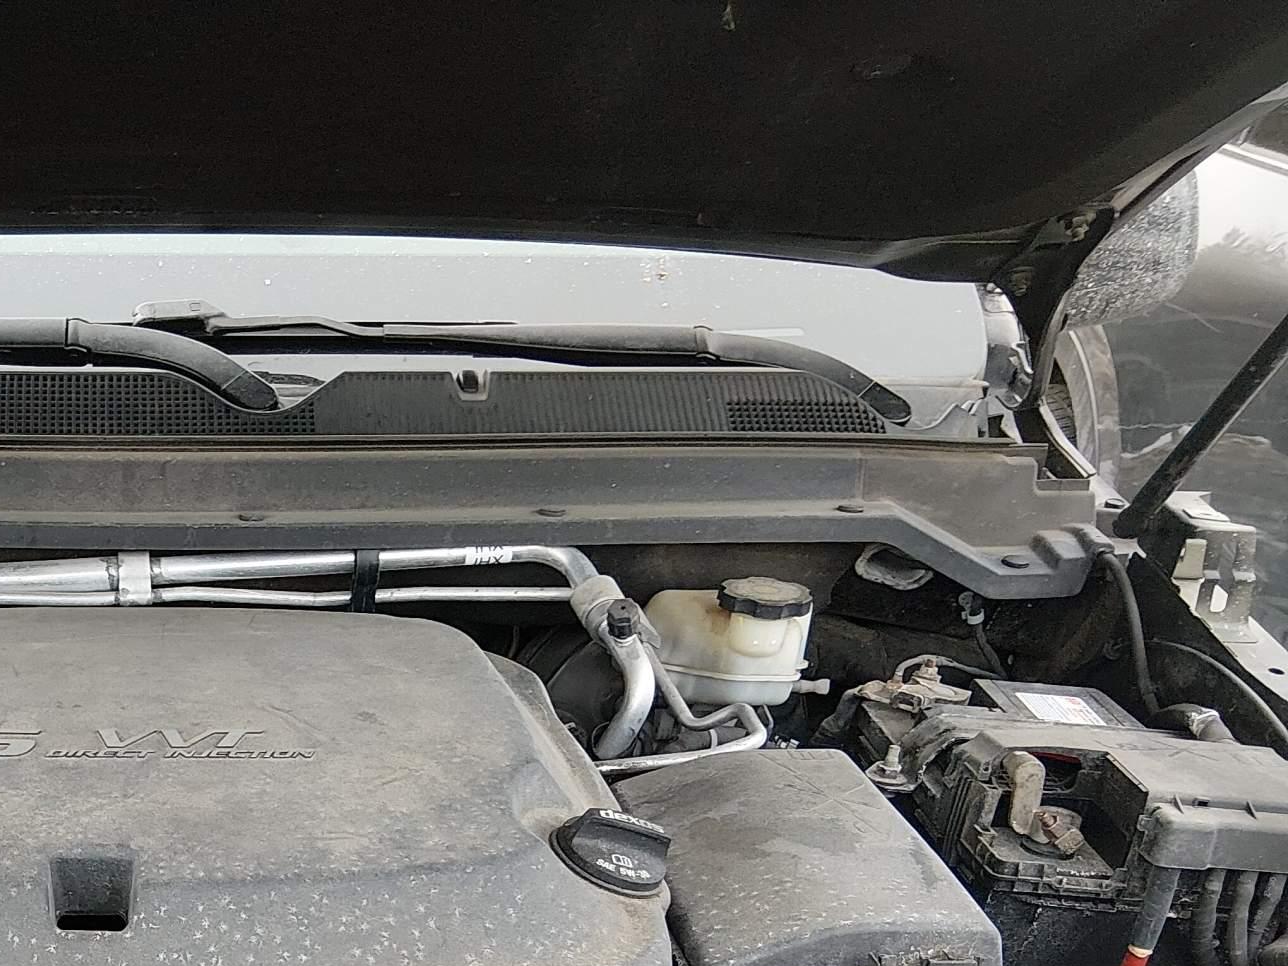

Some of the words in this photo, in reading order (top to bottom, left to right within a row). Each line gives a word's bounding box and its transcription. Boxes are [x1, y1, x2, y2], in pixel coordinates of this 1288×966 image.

[96, 728, 266, 749] VVT
[46, 749, 155, 760] DIRECT
[163, 749, 318, 760] INJECTION
[599, 809, 665, 834] dexos
[596, 859, 616, 872] SAE
